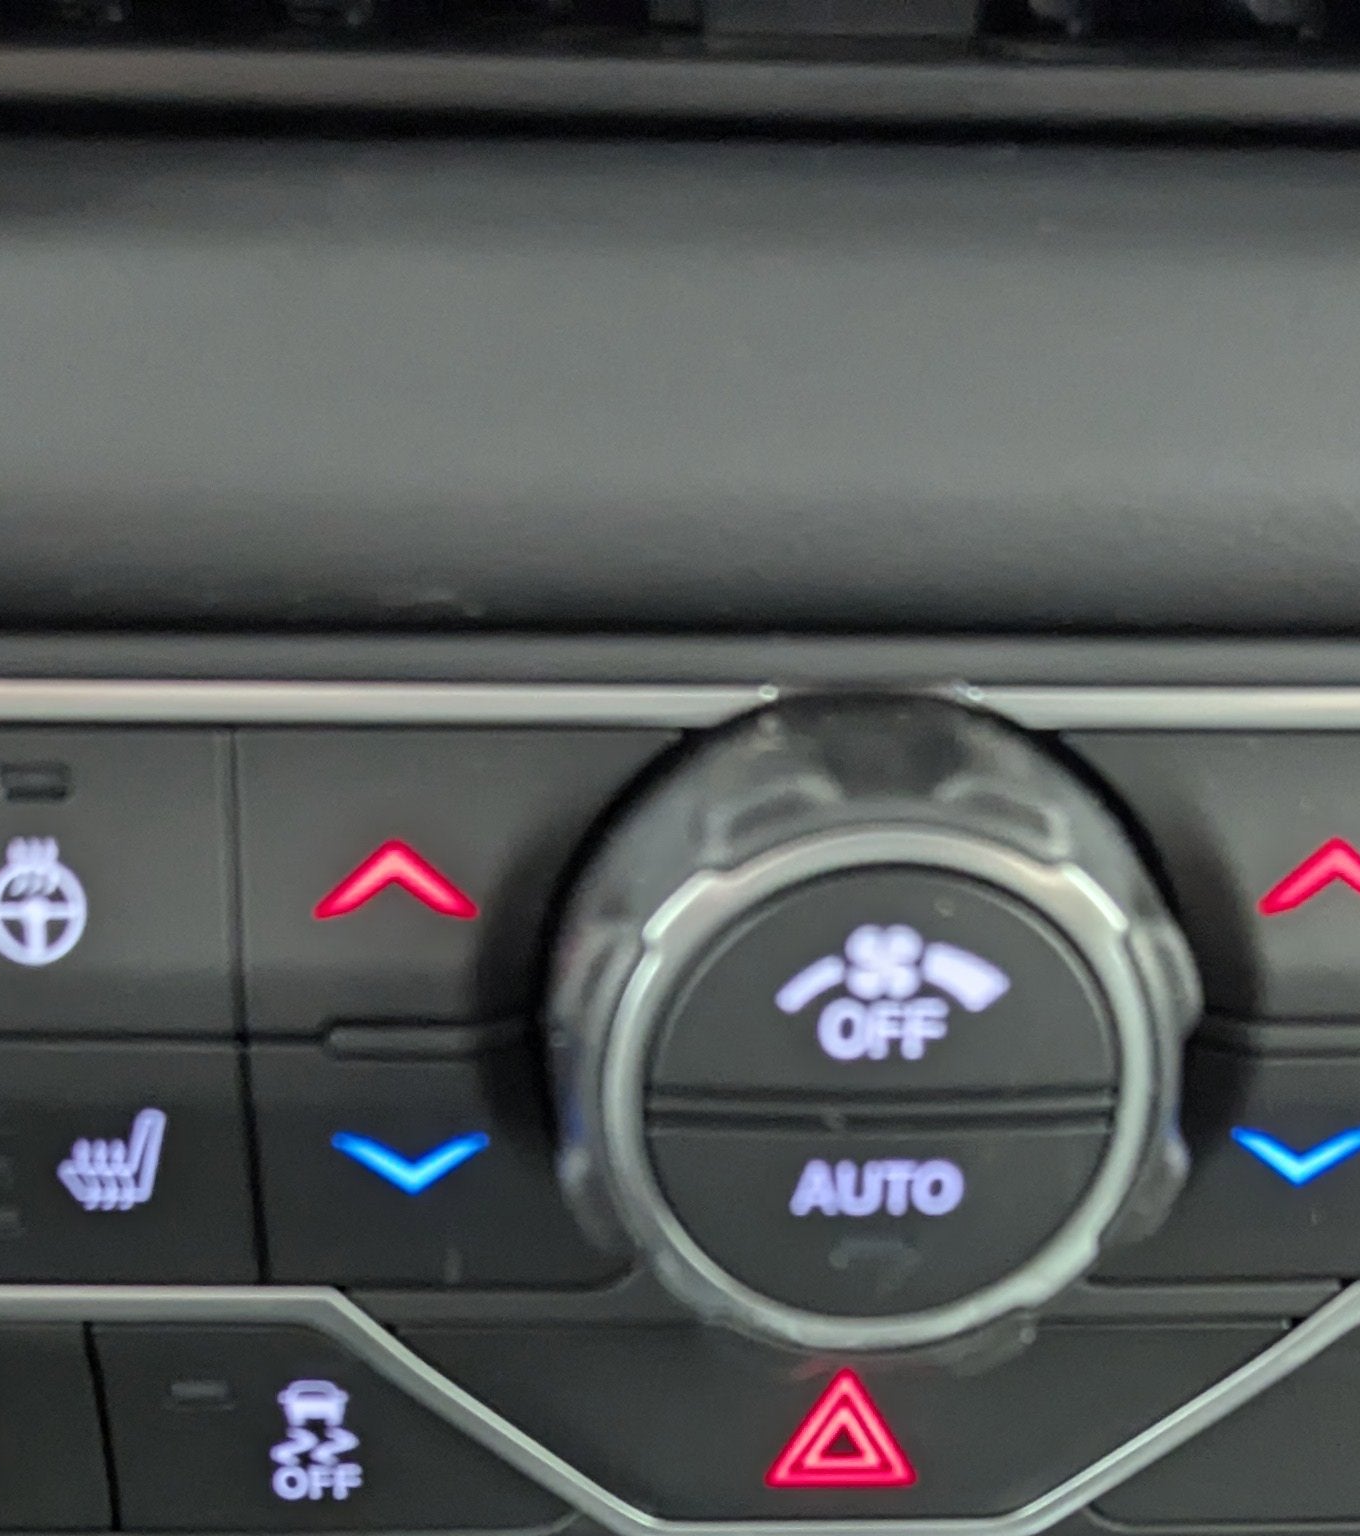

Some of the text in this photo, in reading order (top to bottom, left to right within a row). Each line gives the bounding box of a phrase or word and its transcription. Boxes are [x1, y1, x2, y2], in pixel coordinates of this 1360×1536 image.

[817, 998, 949, 1060] OFF
[789, 1159, 965, 1217] AUTO
[272, 1462, 362, 1501] OFF
